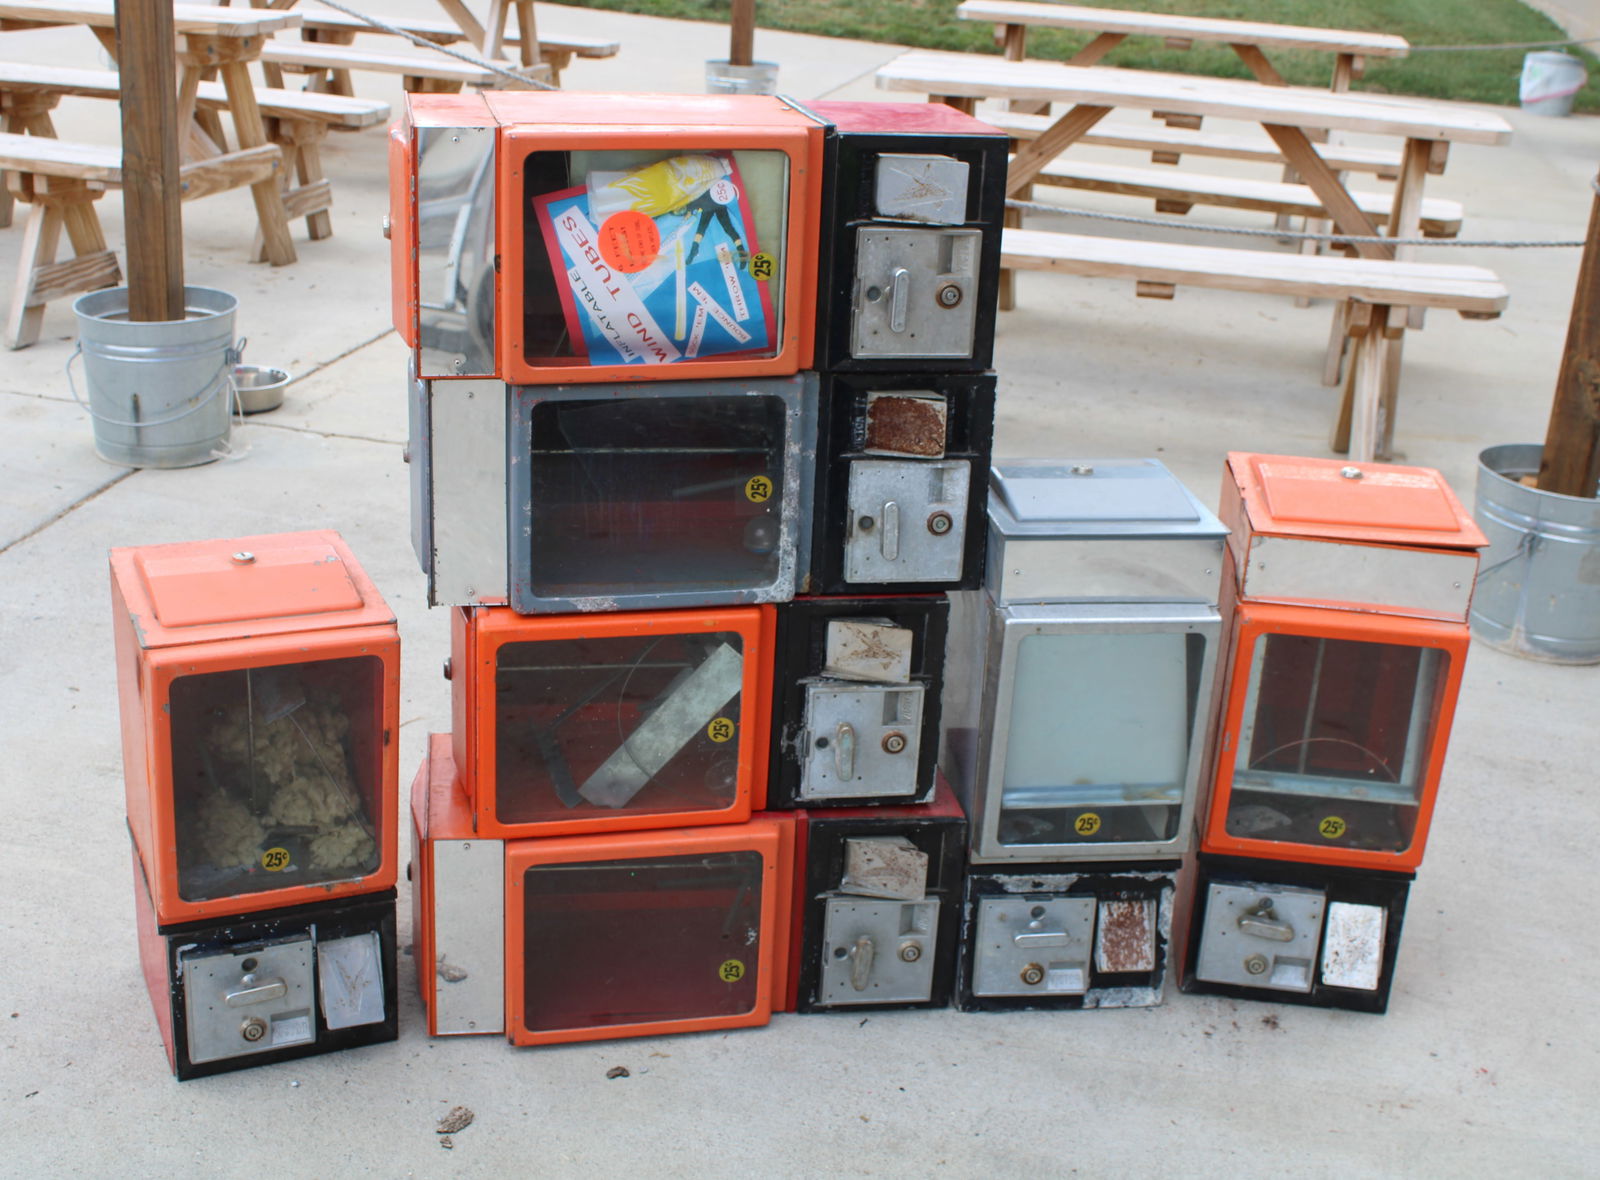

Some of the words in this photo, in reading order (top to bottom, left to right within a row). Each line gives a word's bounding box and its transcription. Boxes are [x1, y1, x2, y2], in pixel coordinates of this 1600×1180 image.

[562, 215, 621, 302] TUBES
[570, 269, 635, 358] INFLATABLE
[728, 275, 747, 318] THROW
[627, 312, 668, 363] WIND
[714, 308, 748, 343] BOUNCE
